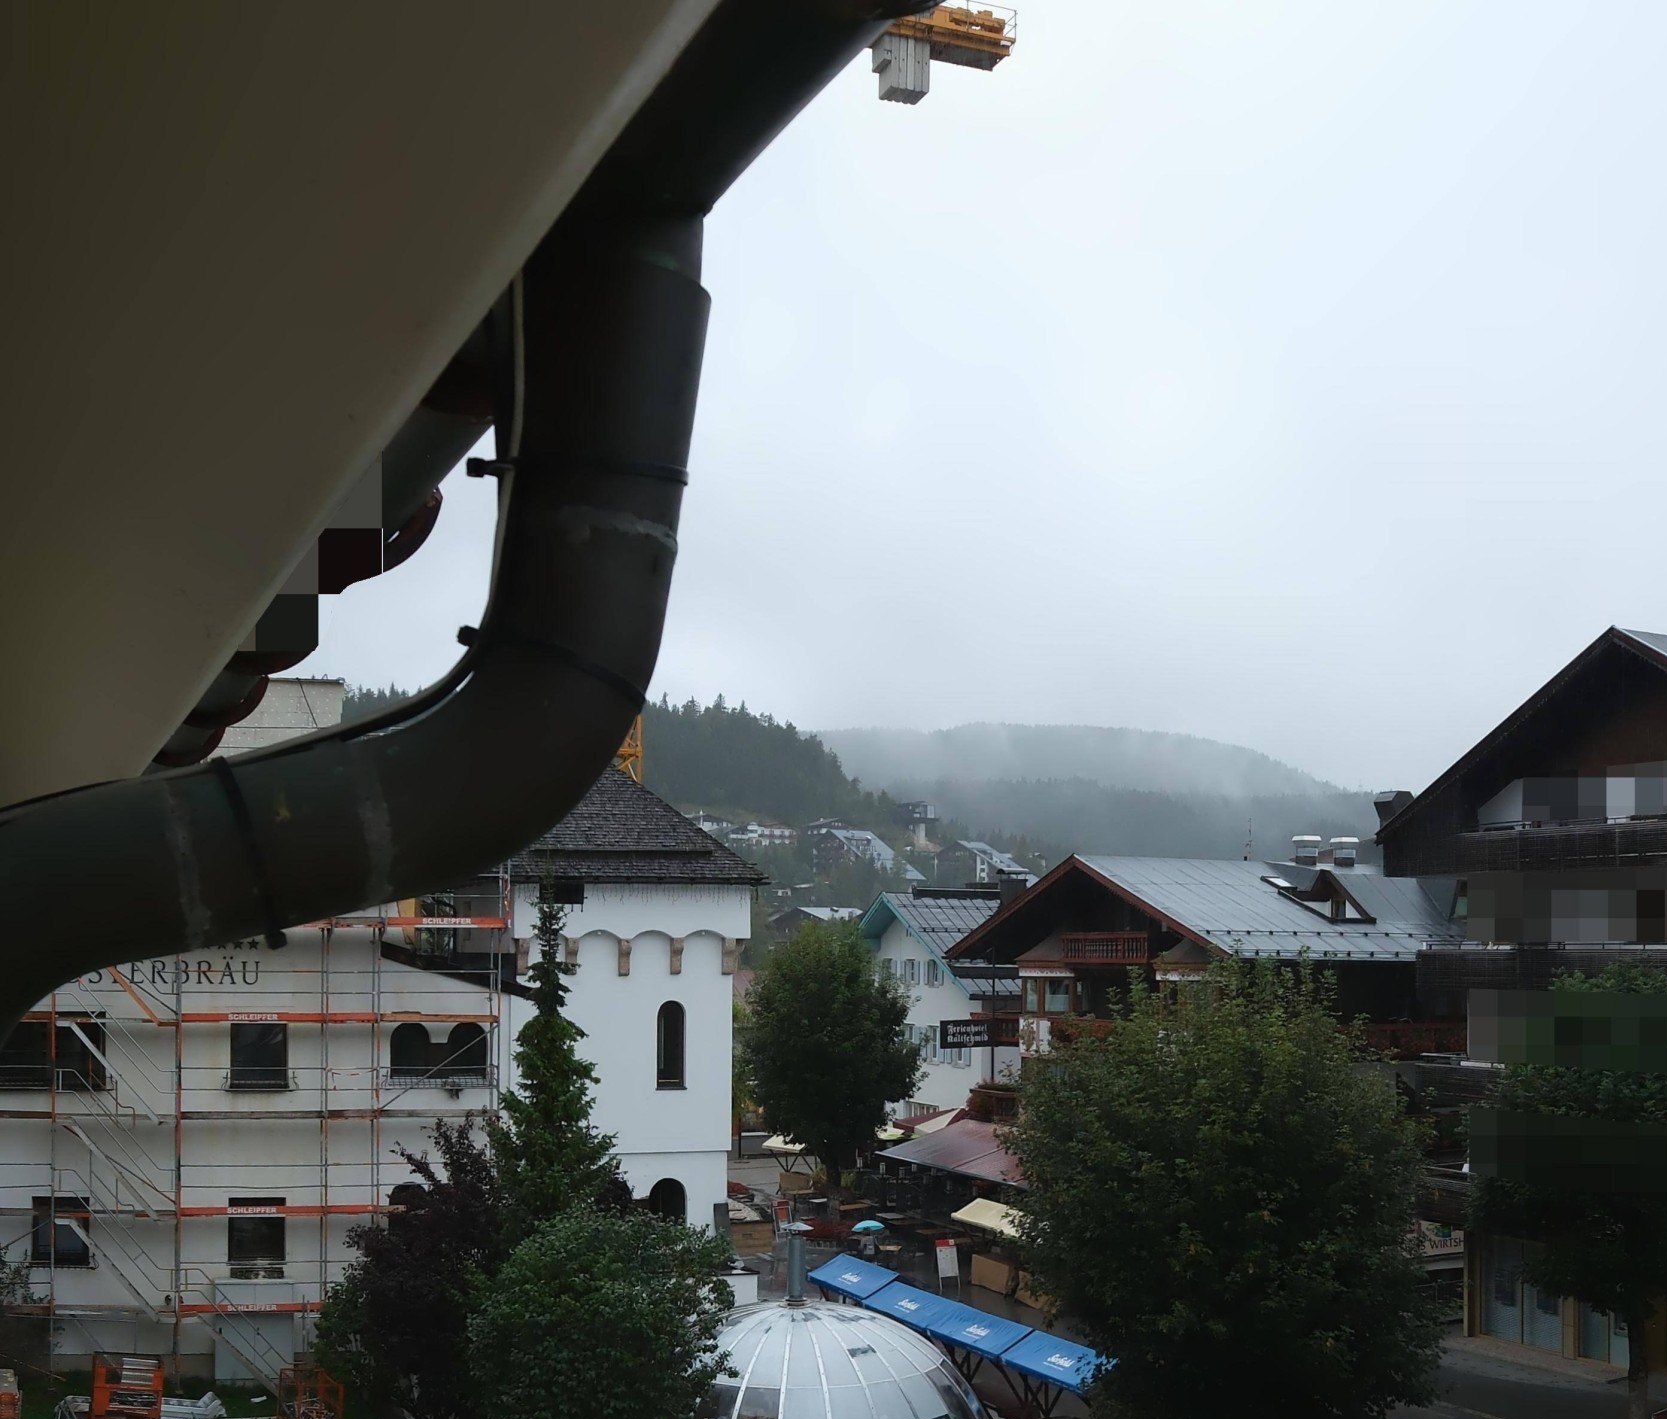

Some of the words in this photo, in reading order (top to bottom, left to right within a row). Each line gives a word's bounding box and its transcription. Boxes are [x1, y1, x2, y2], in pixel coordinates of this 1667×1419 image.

[422, 917, 472, 926] SCHLEIPFER
[228, 1013, 278, 1021] SCHLEIPFER
[226, 1206, 277, 1214] SCHLEIPFER
[227, 1304, 277, 1312] SCHLEIPFER
